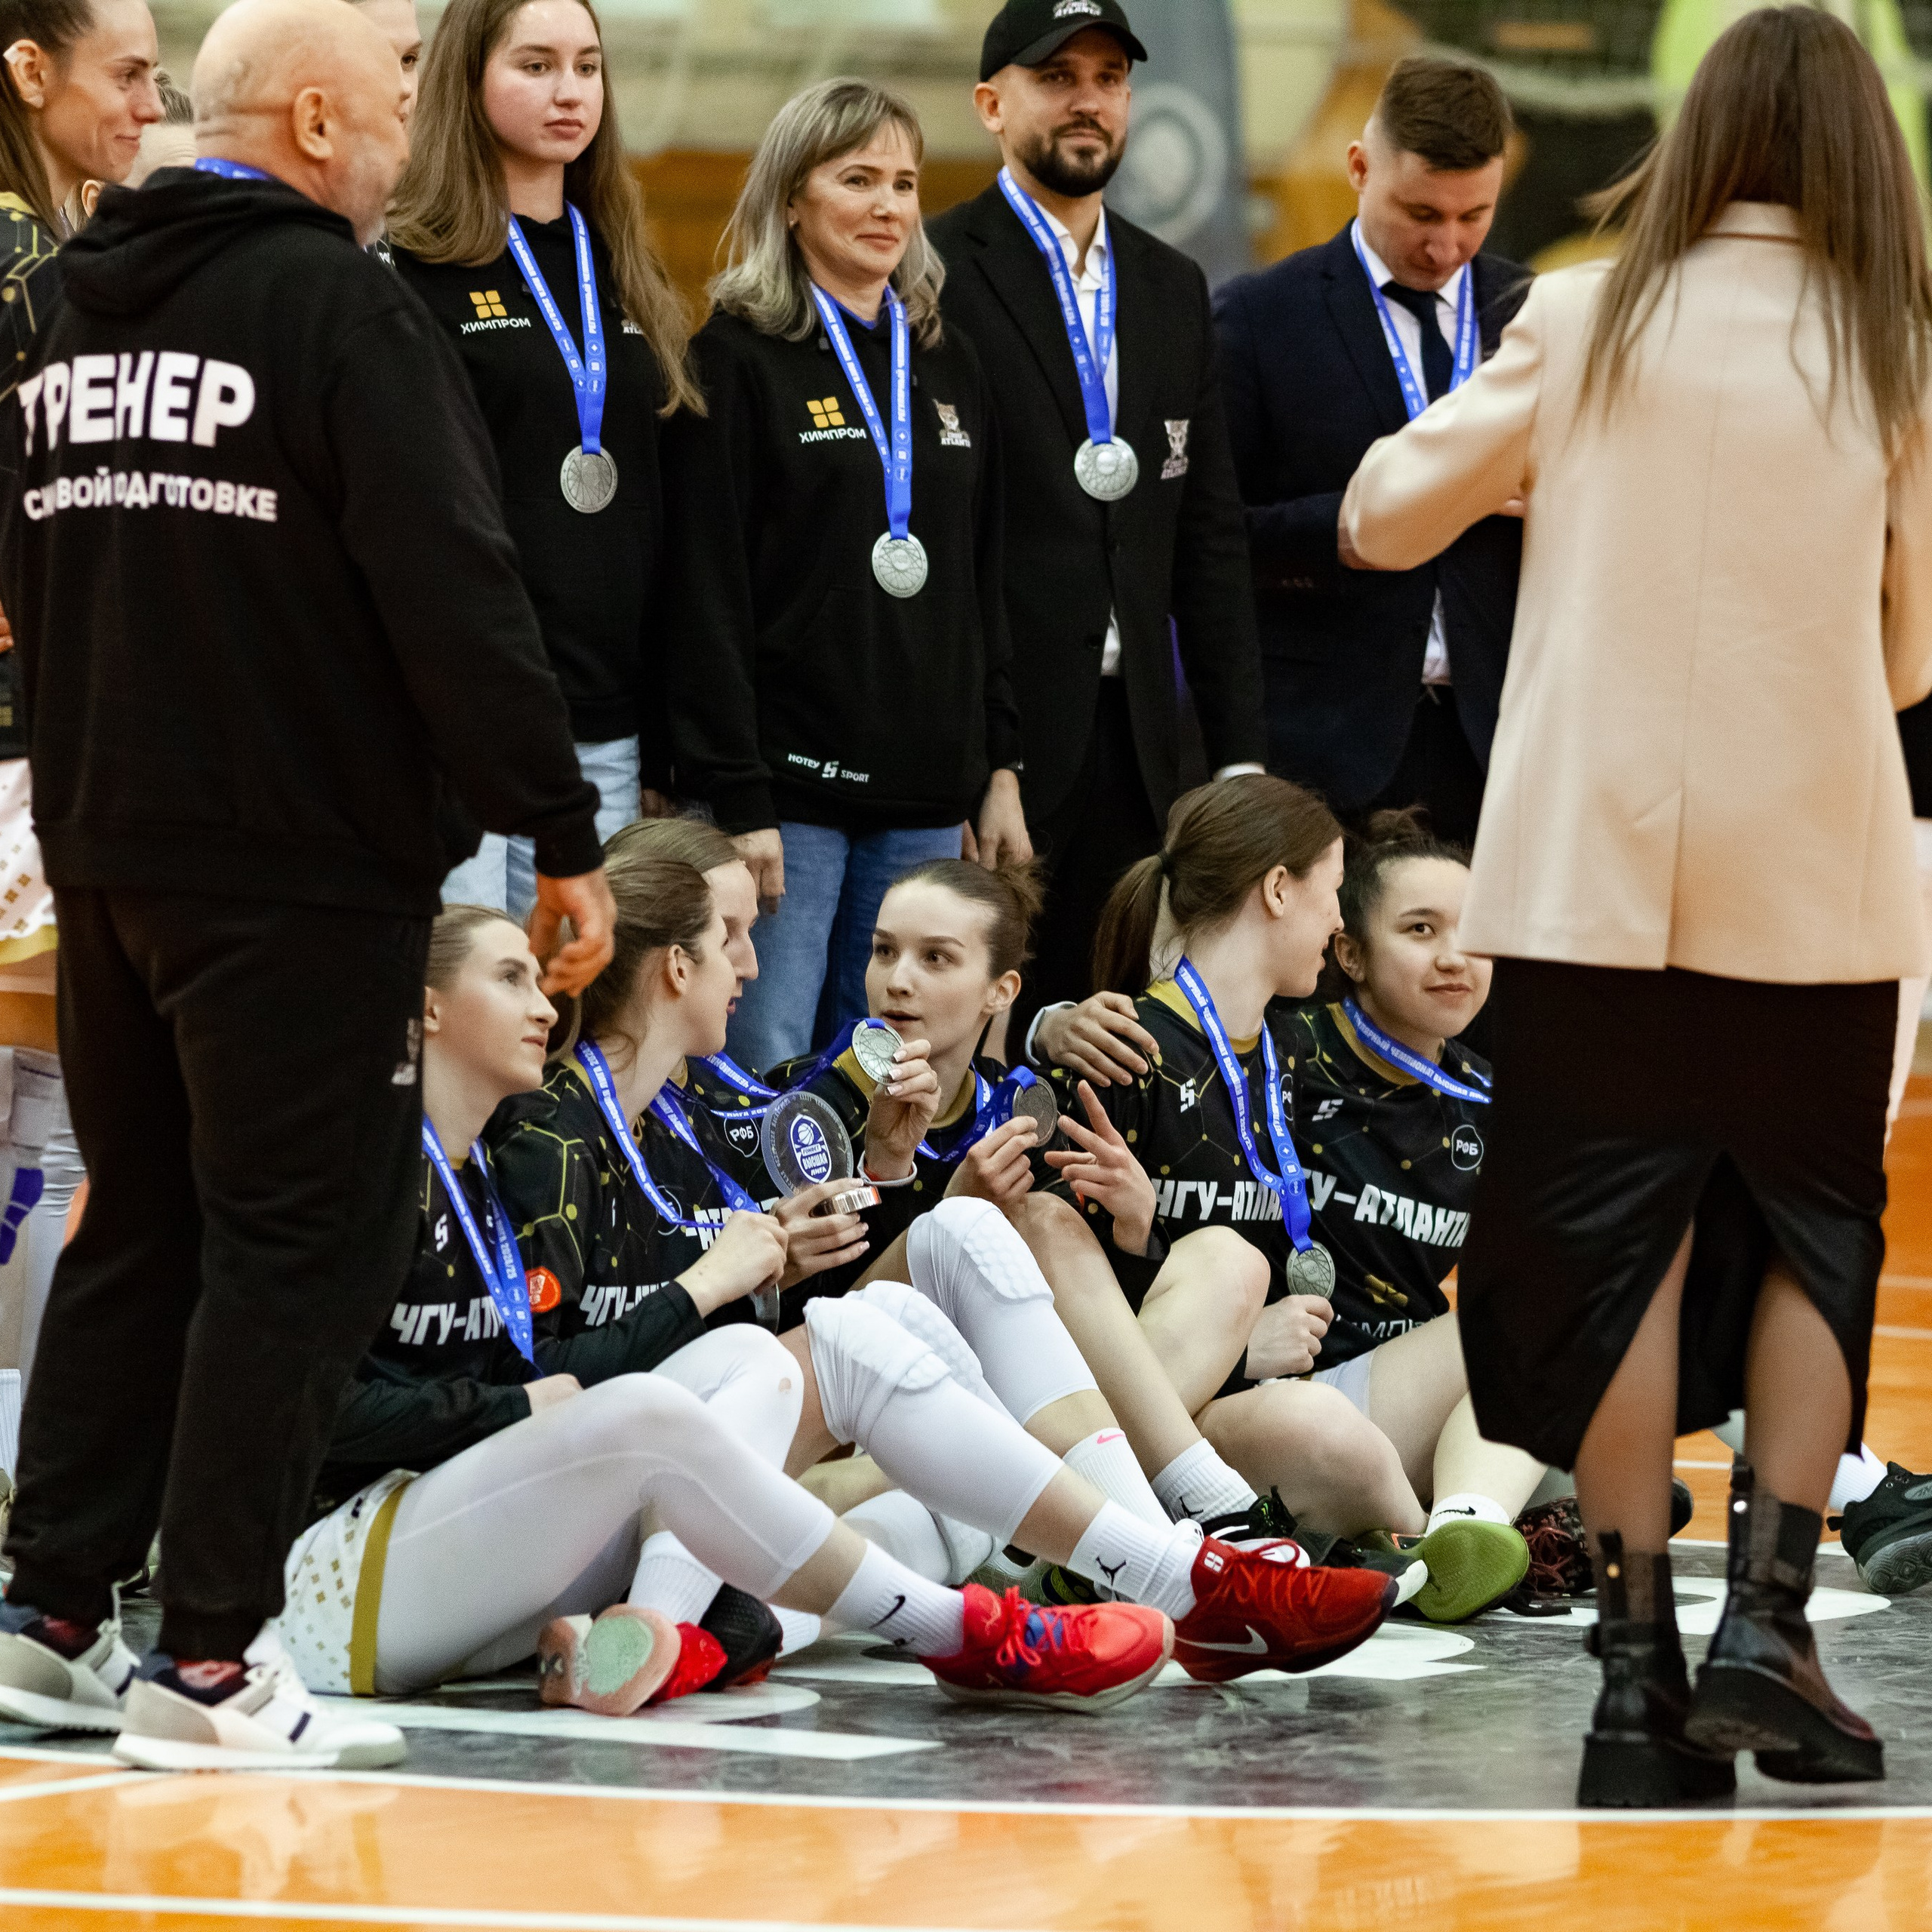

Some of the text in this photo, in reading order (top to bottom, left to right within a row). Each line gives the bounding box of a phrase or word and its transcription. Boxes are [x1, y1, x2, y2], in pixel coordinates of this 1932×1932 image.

[378, 251, 391, 265] РФ
[460, 318, 531, 334] ХИМПРОМ
[17, 351, 256, 457] ТРЕНЕР
[798, 428, 866, 444] ХИМПРОМ
[788, 753, 869, 783] HOTEY SPORT
[1203, 1007, 1228, 1056] ЧЕМПИОНАТ
[1223, 1057, 1242, 1095] ВЫСШАЯ
[1240, 1116, 1253, 1151] 2024/25
[1281, 1091, 1292, 1104] РФ
[729, 1125, 754, 1142] РФБ
[1455, 1139, 1479, 1156] РФБ
[801, 1152, 828, 1170] ВЫСШАЯ
[811, 1166, 827, 1176] ЛИГА
[1151, 1178, 1283, 1220] ЧГУ-АТЛА
[389, 1296, 506, 1346] ЧГУ-АТЛ
